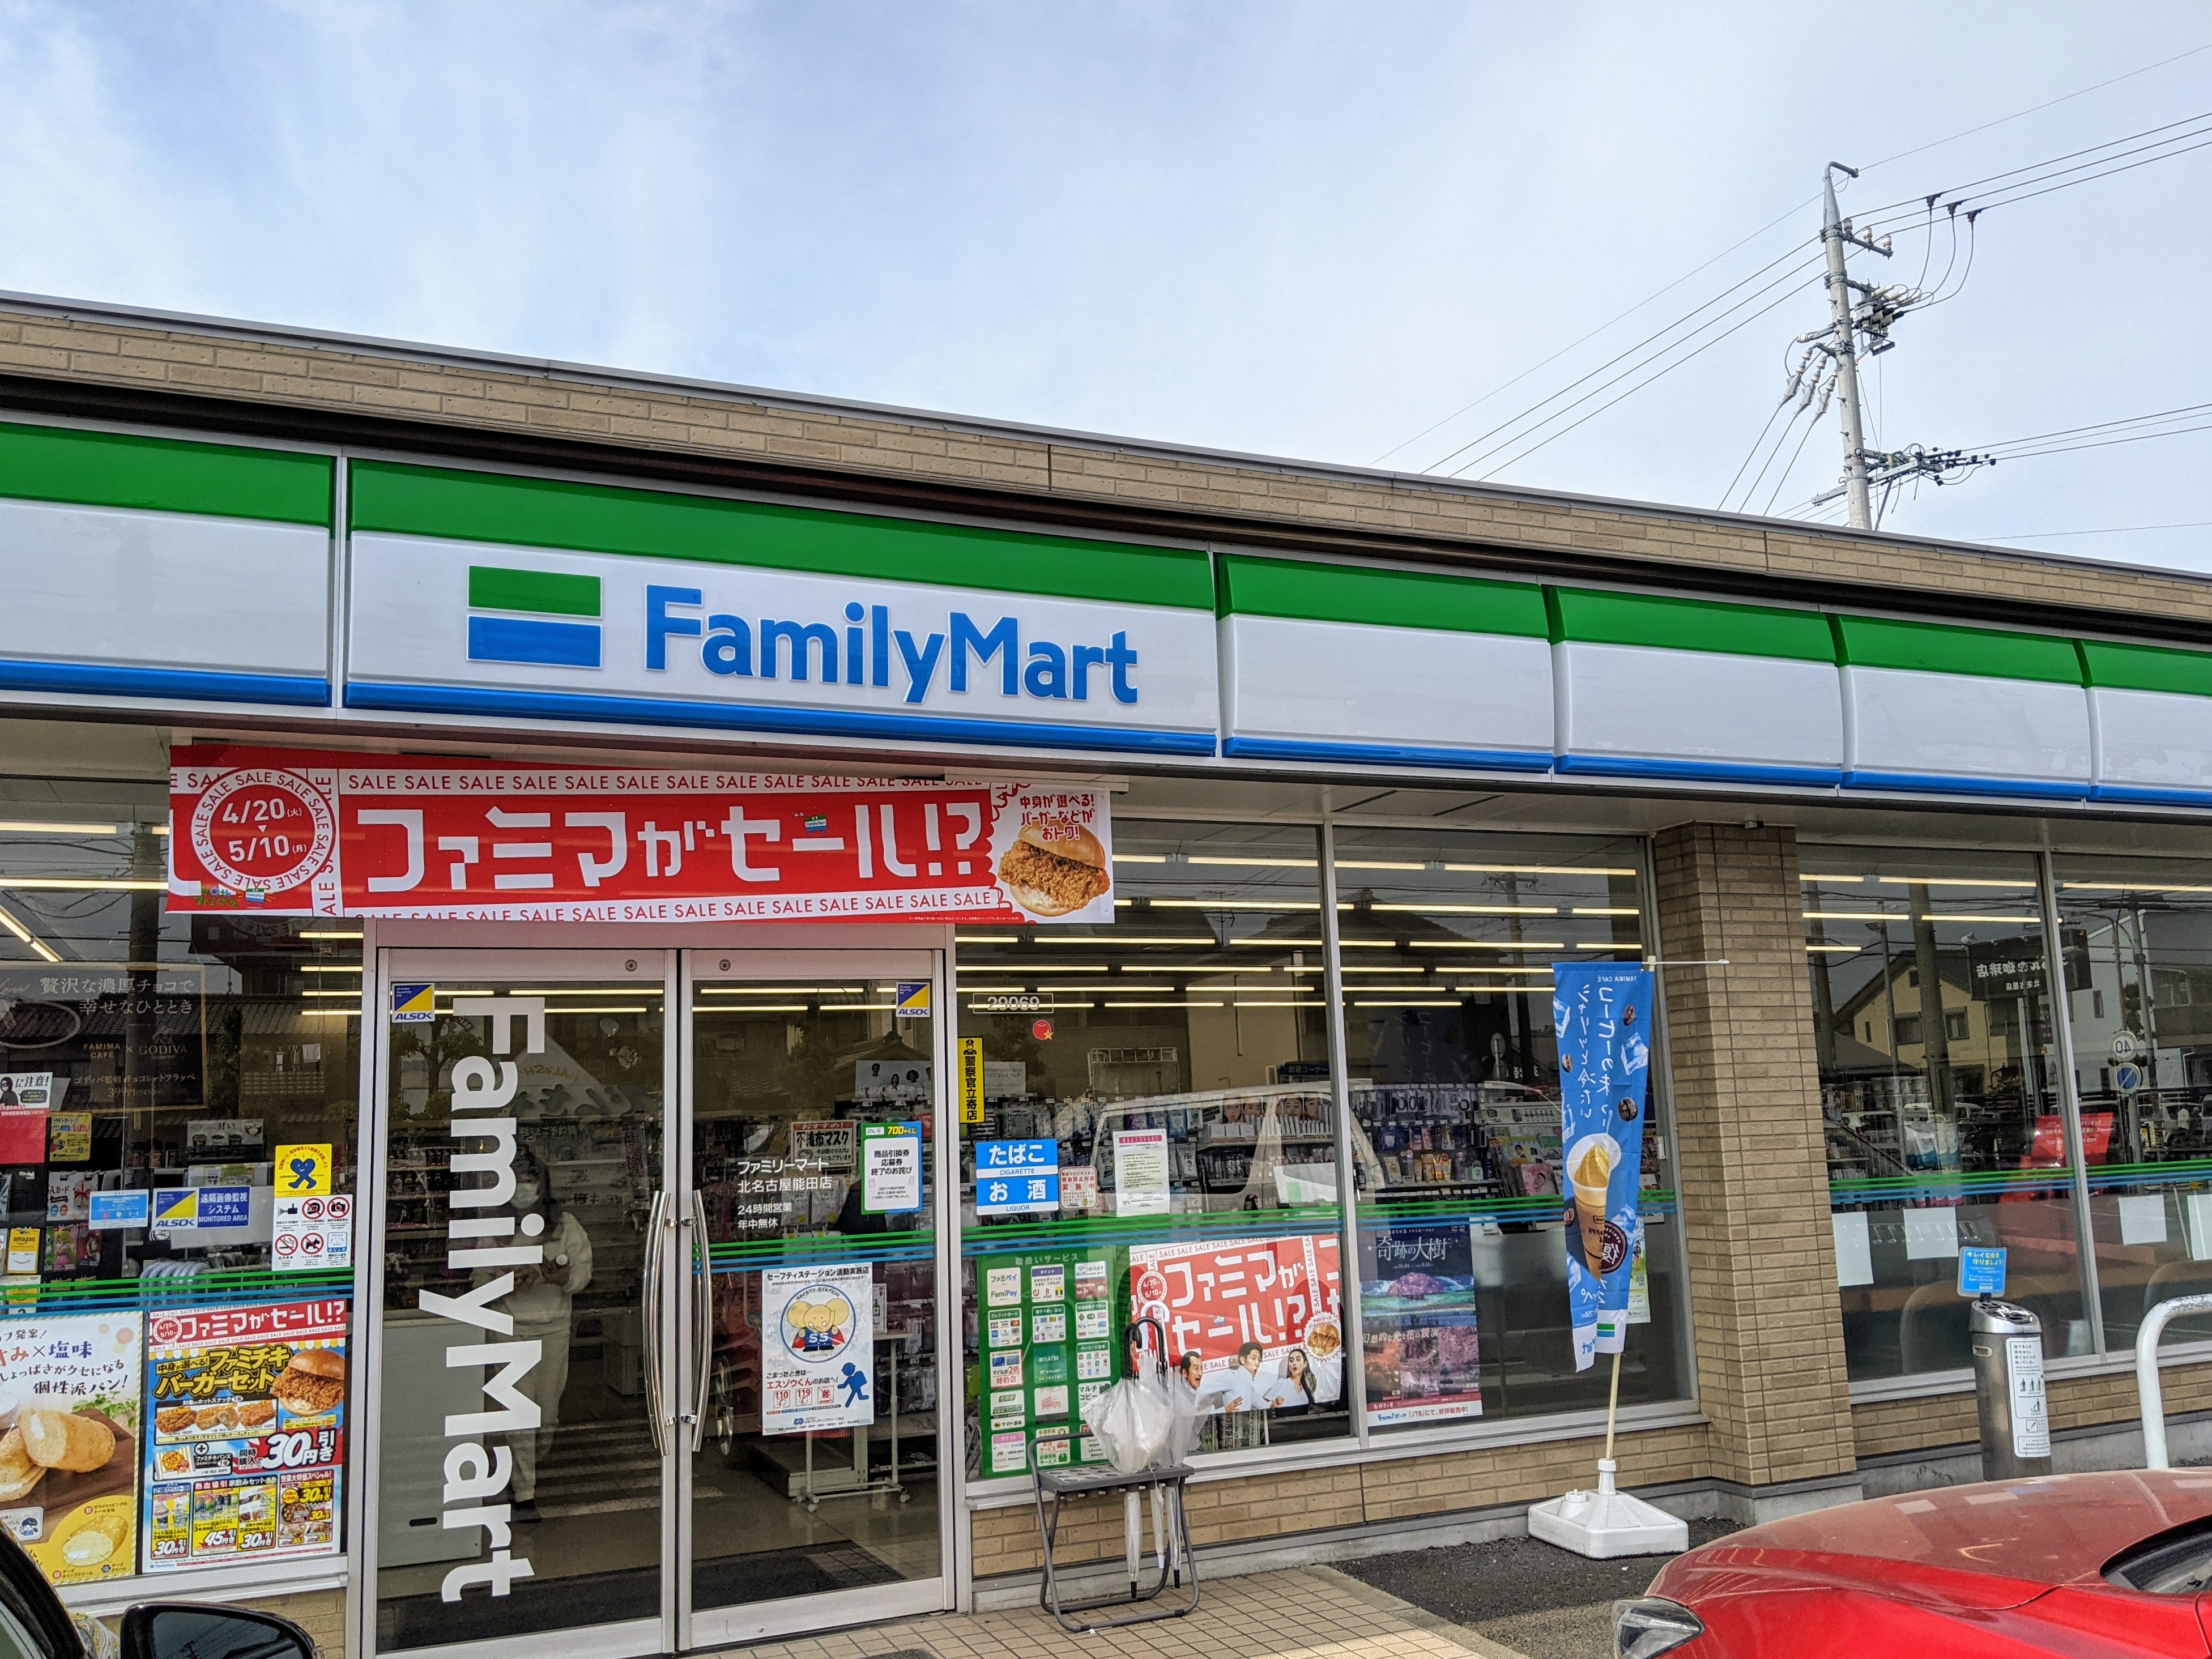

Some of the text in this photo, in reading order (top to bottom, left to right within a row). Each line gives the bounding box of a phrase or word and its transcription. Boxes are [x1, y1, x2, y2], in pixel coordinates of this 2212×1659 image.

[645, 583, 1139, 706] FamilyMart
[236, 771, 272, 786] SALE
[277, 774, 312, 799] SALE
[348, 775, 397, 790] SALE
[405, 775, 450, 790] SALE
[459, 775, 505, 790] SALE
[512, 775, 557, 790] SALE
[565, 775, 609, 790] SALE
[616, 775, 659, 790] SALE
[667, 775, 709, 789] SALE
[717, 775, 756, 788] SALE
[764, 775, 804, 788] SALE
[811, 775, 850, 787] SALE
[201, 781, 233, 812] SALE
[1020, 793, 1095, 809] 中身が選べる!
[309, 798, 329, 829] SALE
[1021, 808, 1096, 826] バーガーなどが
[194, 812, 209, 847] SALE
[1042, 826, 1080, 841] おトク!
[306, 833, 329, 867] SALE
[199, 849, 233, 880] SALE
[233, 876, 272, 891] SALE
[277, 864, 310, 890] SALE
[520, 909, 564, 922] SALE
[573, 906, 616, 922] SALE
[624, 905, 667, 920] SALE
[675, 903, 717, 918] SALE
[724, 901, 765, 916] SALE
[773, 899, 813, 914] SALE
[819, 897, 860, 912] SALE
[865, 895, 905, 910] SALE
[910, 893, 948, 907] SALE
[953, 892, 991, 906] SALE
[41, 977, 194, 993] 贅沢な濃厚チョコで
[79, 999, 193, 1016] 幸せなひととき
[987, 996, 1040, 1011] 29069
[139, 1045, 187, 1055] GODIVA
[15, 1076, 49, 1087] に注意!
[964, 1056, 978, 1121] 警察官立寄店
[873, 1149, 910, 1159] 商品引換券
[989, 1143, 1045, 1166] たばこ
[738, 1157, 829, 1175] ファミリーマート
[871, 1166, 913, 1176] 終了のお詫び
[738, 1175, 833, 1193] 北名古屋能田店
[201, 1192, 248, 1204] 遠隔画像監視
[208, 1204, 240, 1214] システム
[738, 1202, 792, 1215] 24時間営業
[738, 1217, 778, 1230] 年中無休
[1212, 1240, 1228, 1249] SALE
[1229, 1238, 1245, 1246] SALE
[1378, 1236, 1446, 1261] 奇跡の大樹
[1015, 1253, 1079, 1265] 取扱いサービス
[767, 1266, 870, 1281] セーフティステーション活動実施店
[990, 1274, 1017, 1283] ファミペイ
[1164, 1249, 1304, 1308] ファミマが
[419, 996, 545, 1603] FamilyMart
[796, 1287, 841, 1300] SAFETY STATION
[991, 1289, 1017, 1298] FamiPay
[809, 1332, 829, 1343] SS
[157, 1357, 208, 1373] 中身が選べる!
[209, 1346, 289, 1372] ファミチキ
[1210, 1360, 1226, 1369] SALE
[992, 1366, 1020, 1375] マイルが2倍
[32, 1375, 128, 1396] 個性派パン!
[155, 1368, 275, 1394] バーガーセット
[996, 1375, 1017, 1384] 特約店
